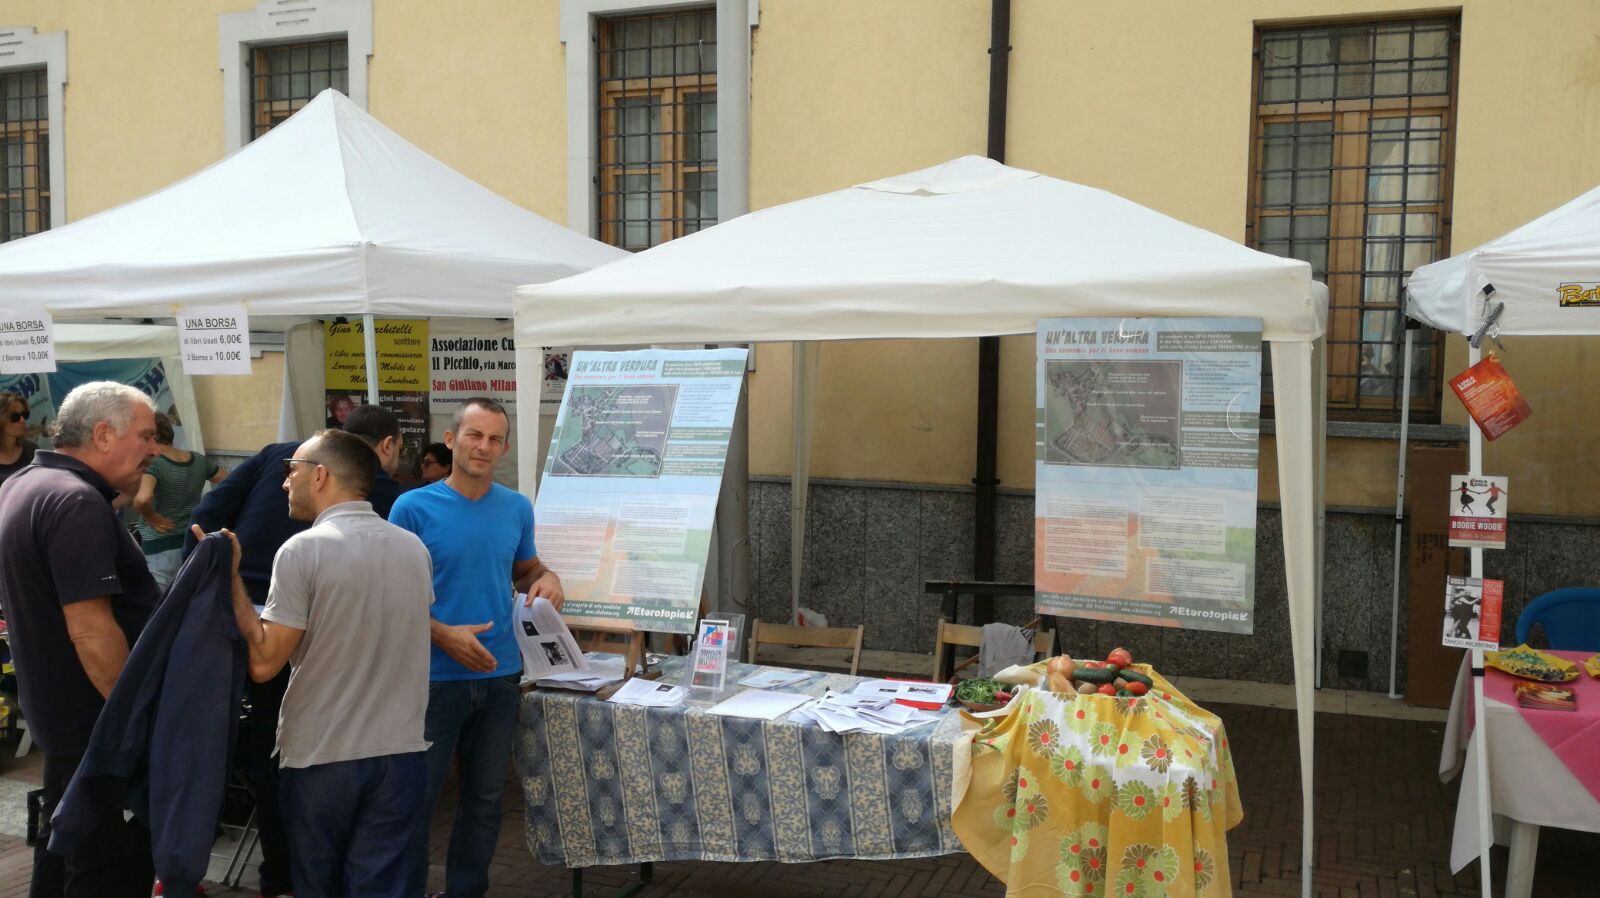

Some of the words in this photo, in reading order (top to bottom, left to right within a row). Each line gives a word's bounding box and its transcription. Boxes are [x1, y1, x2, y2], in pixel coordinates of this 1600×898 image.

[16, 320, 44, 330] BORSA
[185, 319, 203, 328] UNA
[205, 317, 237, 328] BORSA
[329, 322, 351, 336] Gino
[355, 322, 412, 335] Mrchitelli
[30, 335, 49, 346] 6,00€
[219, 334, 242, 345] 6,00€
[1045, 330, 1097, 345] UN'ALTRA
[1101, 330, 1149, 345] VERDURA
[432, 337, 498, 352] Associazione
[28, 351, 49, 360] 10,00€
[215, 351, 241, 361] 10,00€
[432, 357, 440, 370] il
[443, 357, 483, 372] Picchio,
[484, 361, 496, 370] via
[576, 360, 618, 373] UN'ALTRA
[620, 359, 658, 372] VERDURA
[432, 380, 446, 391] San
[449, 379, 487, 391] Giuliano
[490, 379, 516, 391] Milan
[1452, 521, 1476, 530] BOOGIE
[1478, 522, 1503, 531] WOOGIE
[1465, 641, 1497, 650] ARGENTINO
